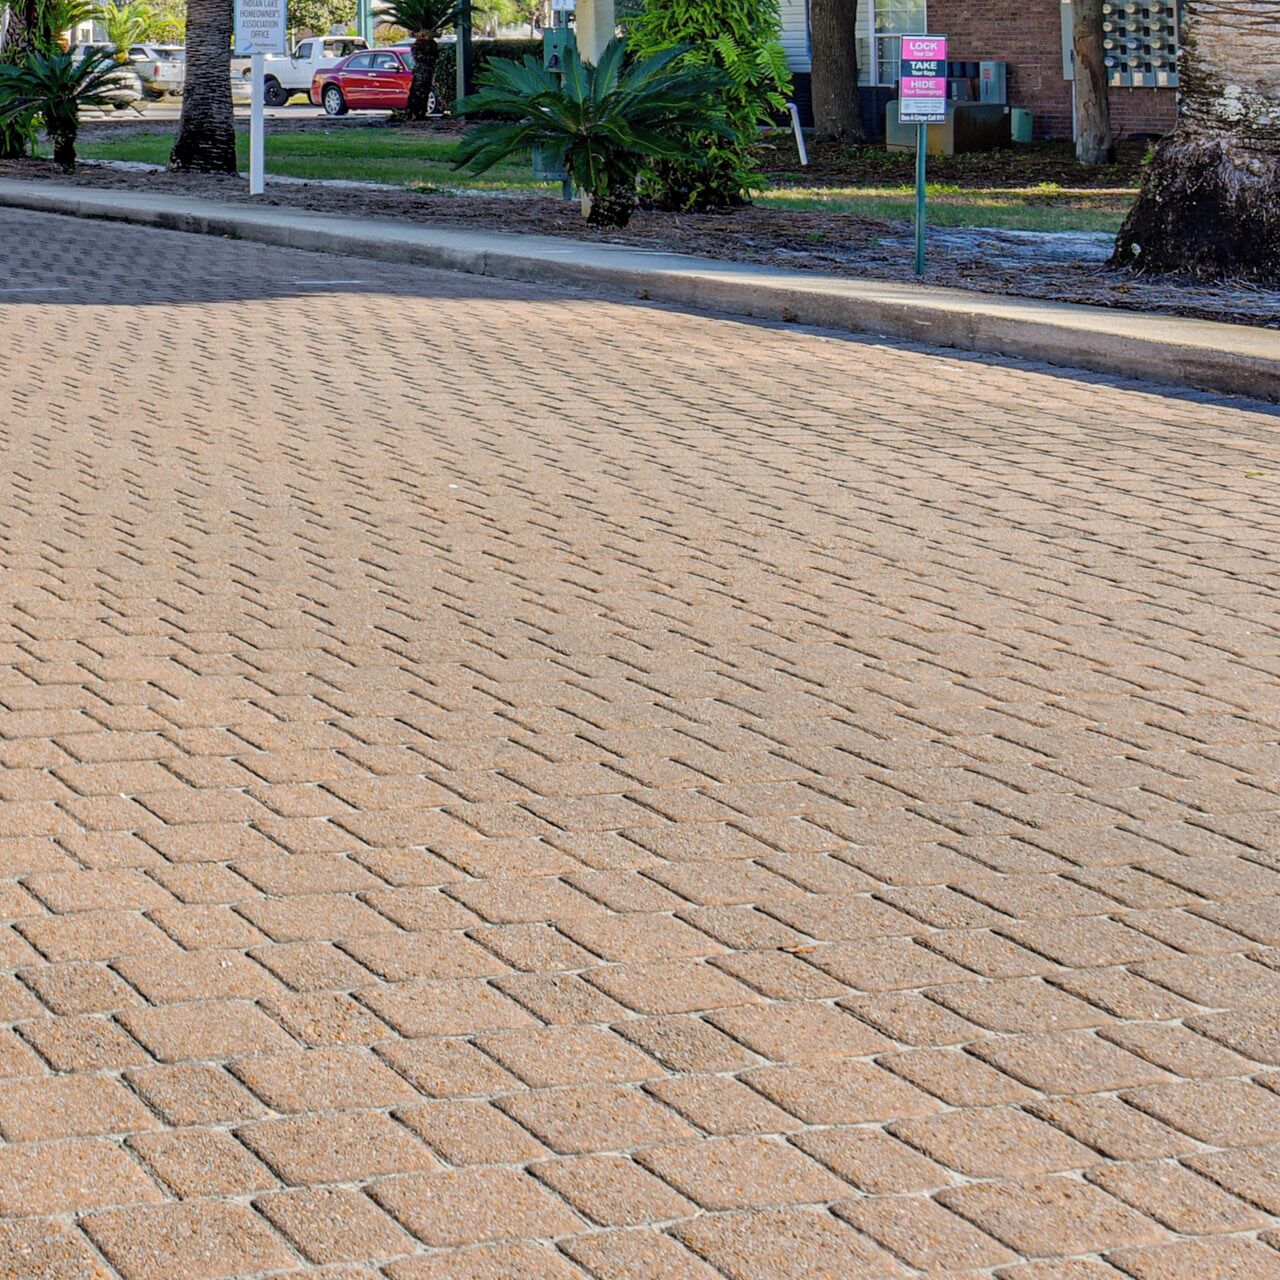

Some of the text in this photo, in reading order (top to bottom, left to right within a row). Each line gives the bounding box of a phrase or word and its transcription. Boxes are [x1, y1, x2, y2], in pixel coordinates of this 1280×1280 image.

[243, 0, 278, 8] INDIAN LAKE
[242, 20, 279, 28] ASSOCIATION
[251, 30, 270, 39] OFFICE
[909, 42, 938, 50] LOCK
[909, 61, 938, 70] TAKE
[911, 81, 936, 89] HIDE
